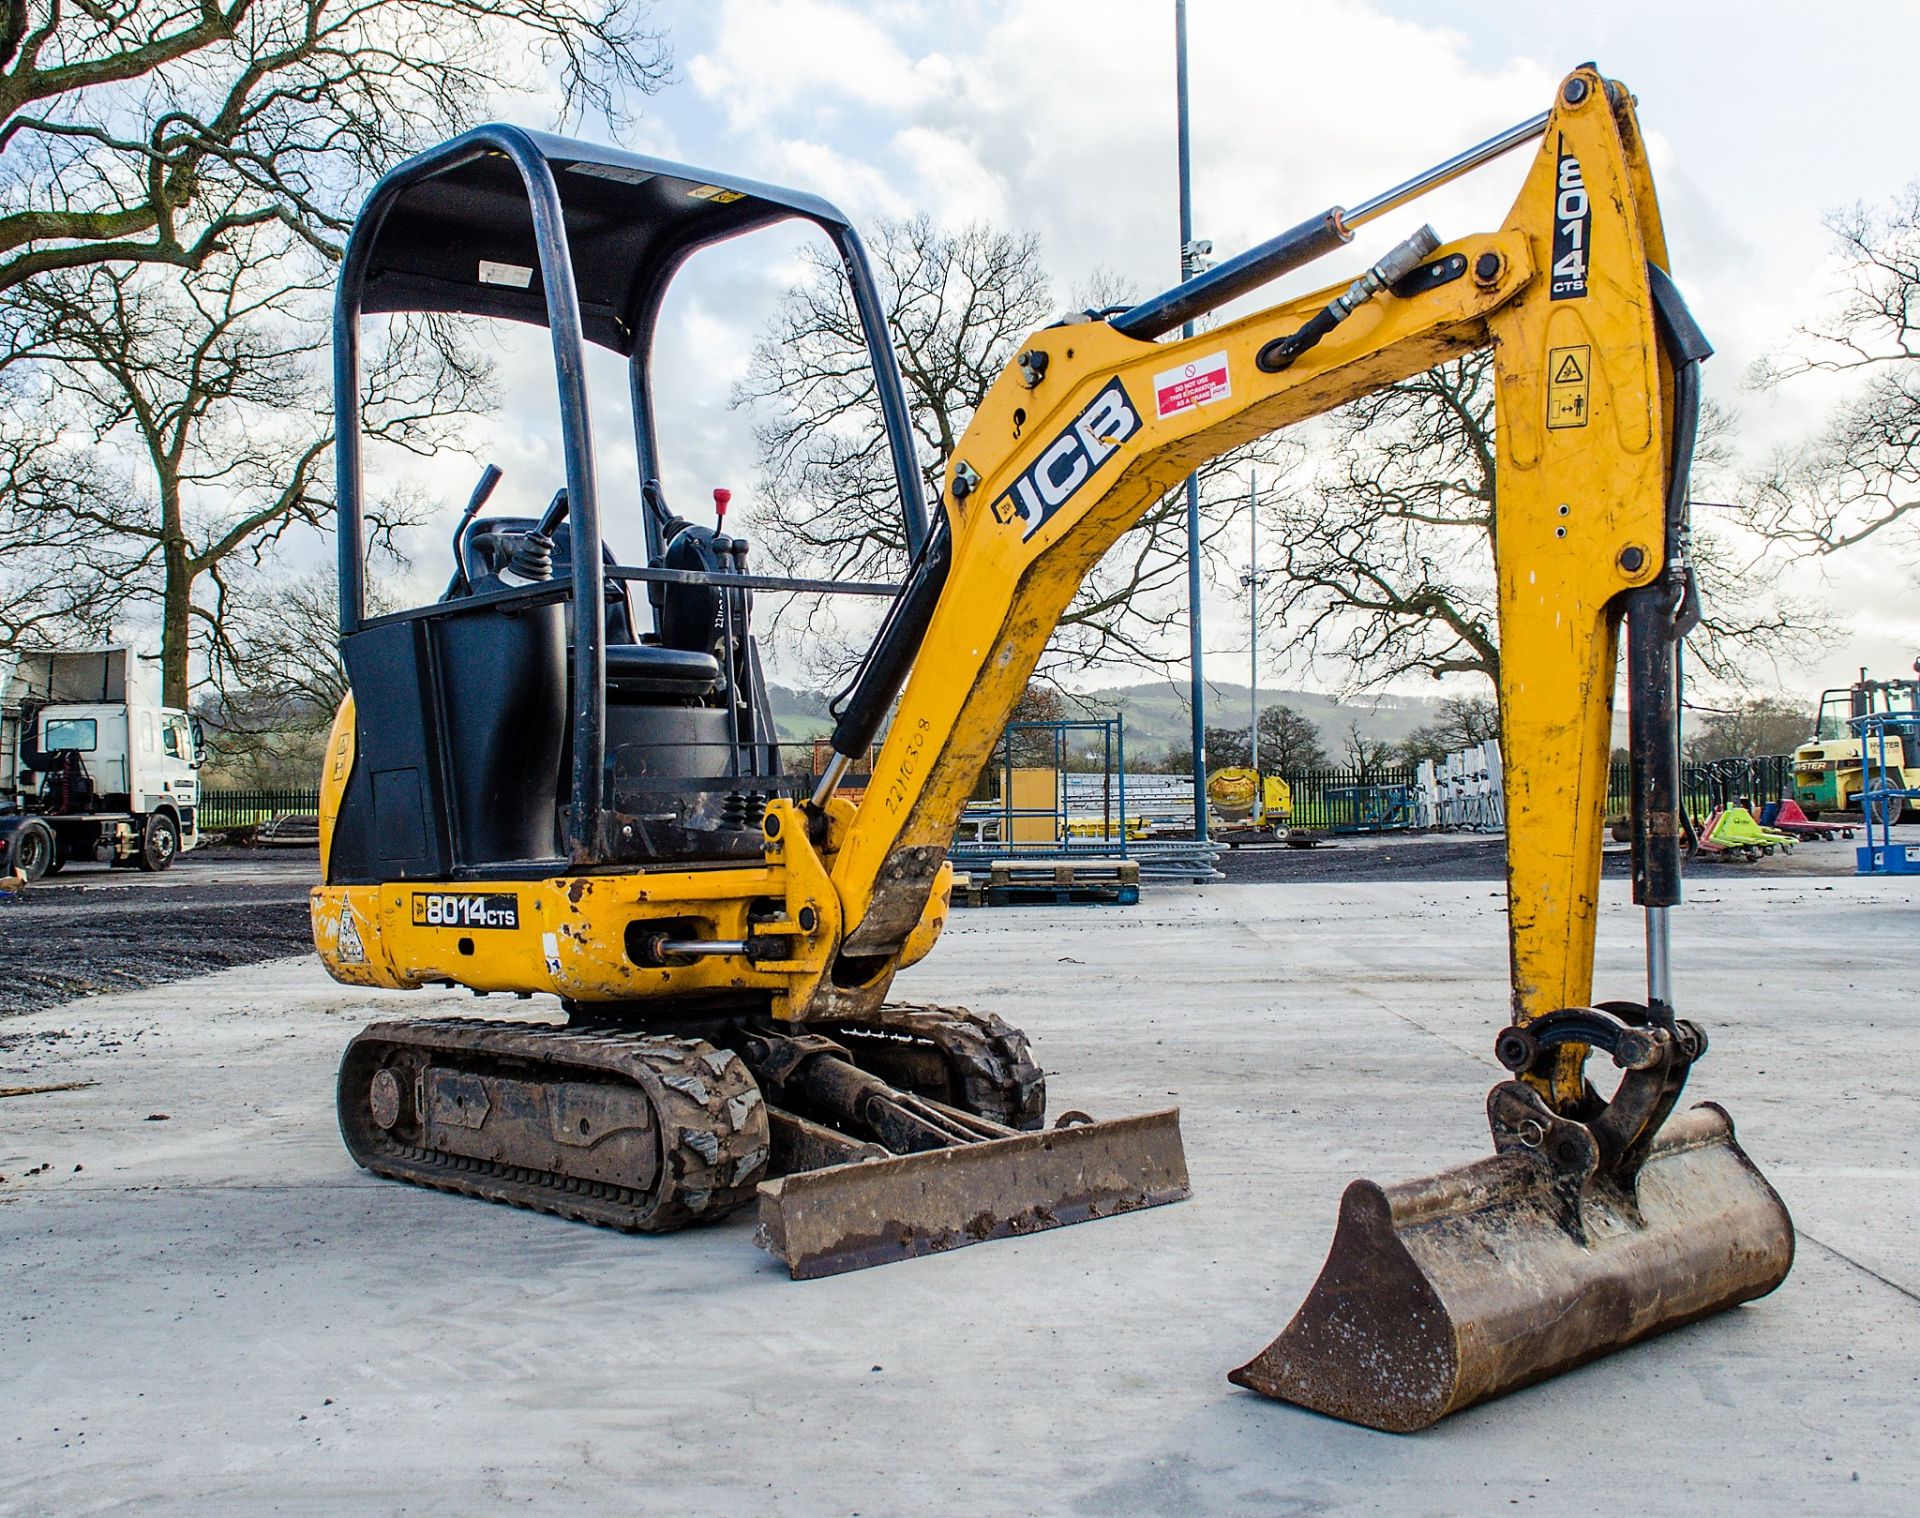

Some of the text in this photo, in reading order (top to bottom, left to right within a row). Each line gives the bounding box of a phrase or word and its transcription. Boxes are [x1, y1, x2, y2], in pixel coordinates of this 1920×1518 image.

[1553, 158, 1589, 280] 8014
[1553, 280, 1584, 293] CTS
[1174, 376, 1209, 393] DO NOT USE
[1169, 392, 1183, 402] THIS
[1176, 399, 1186, 408] AS
[1022, 389, 1135, 539] JCB
